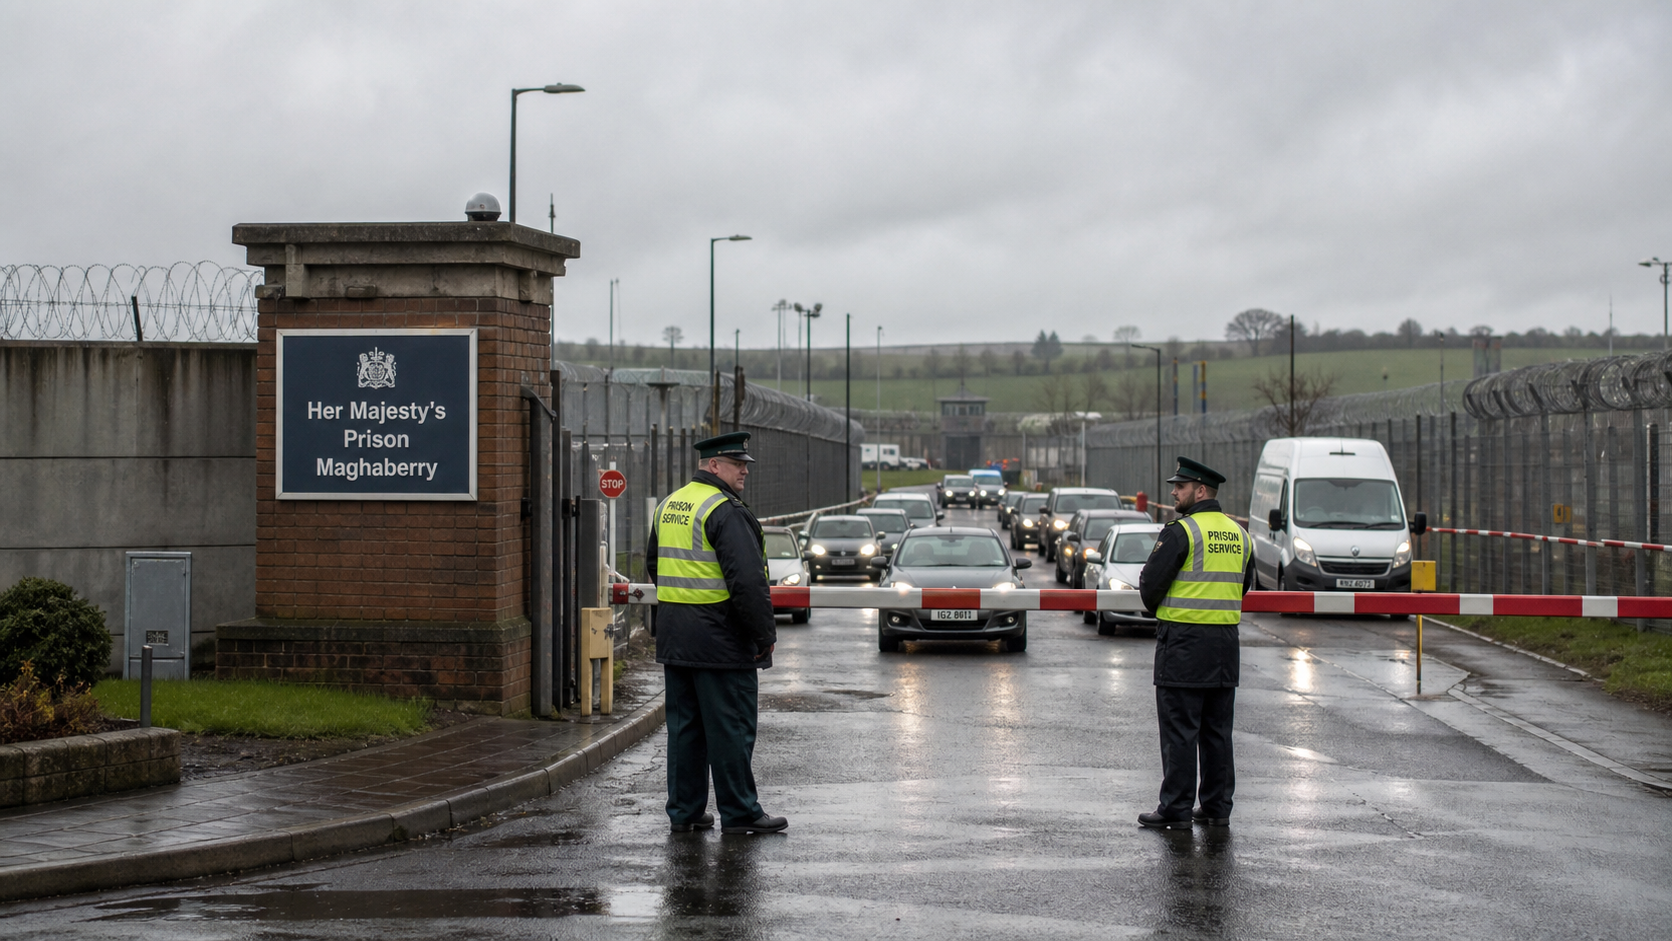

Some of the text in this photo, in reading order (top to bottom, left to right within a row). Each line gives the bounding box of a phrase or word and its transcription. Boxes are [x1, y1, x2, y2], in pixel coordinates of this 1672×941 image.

[307, 401, 446, 424] Her Majesty's
[344, 429, 409, 448] Prison
[316, 458, 438, 481] Maghaberry
[601, 479, 624, 489] STOP
[1207, 530, 1239, 542] PRISON
[1207, 543, 1242, 555] SERVICE
